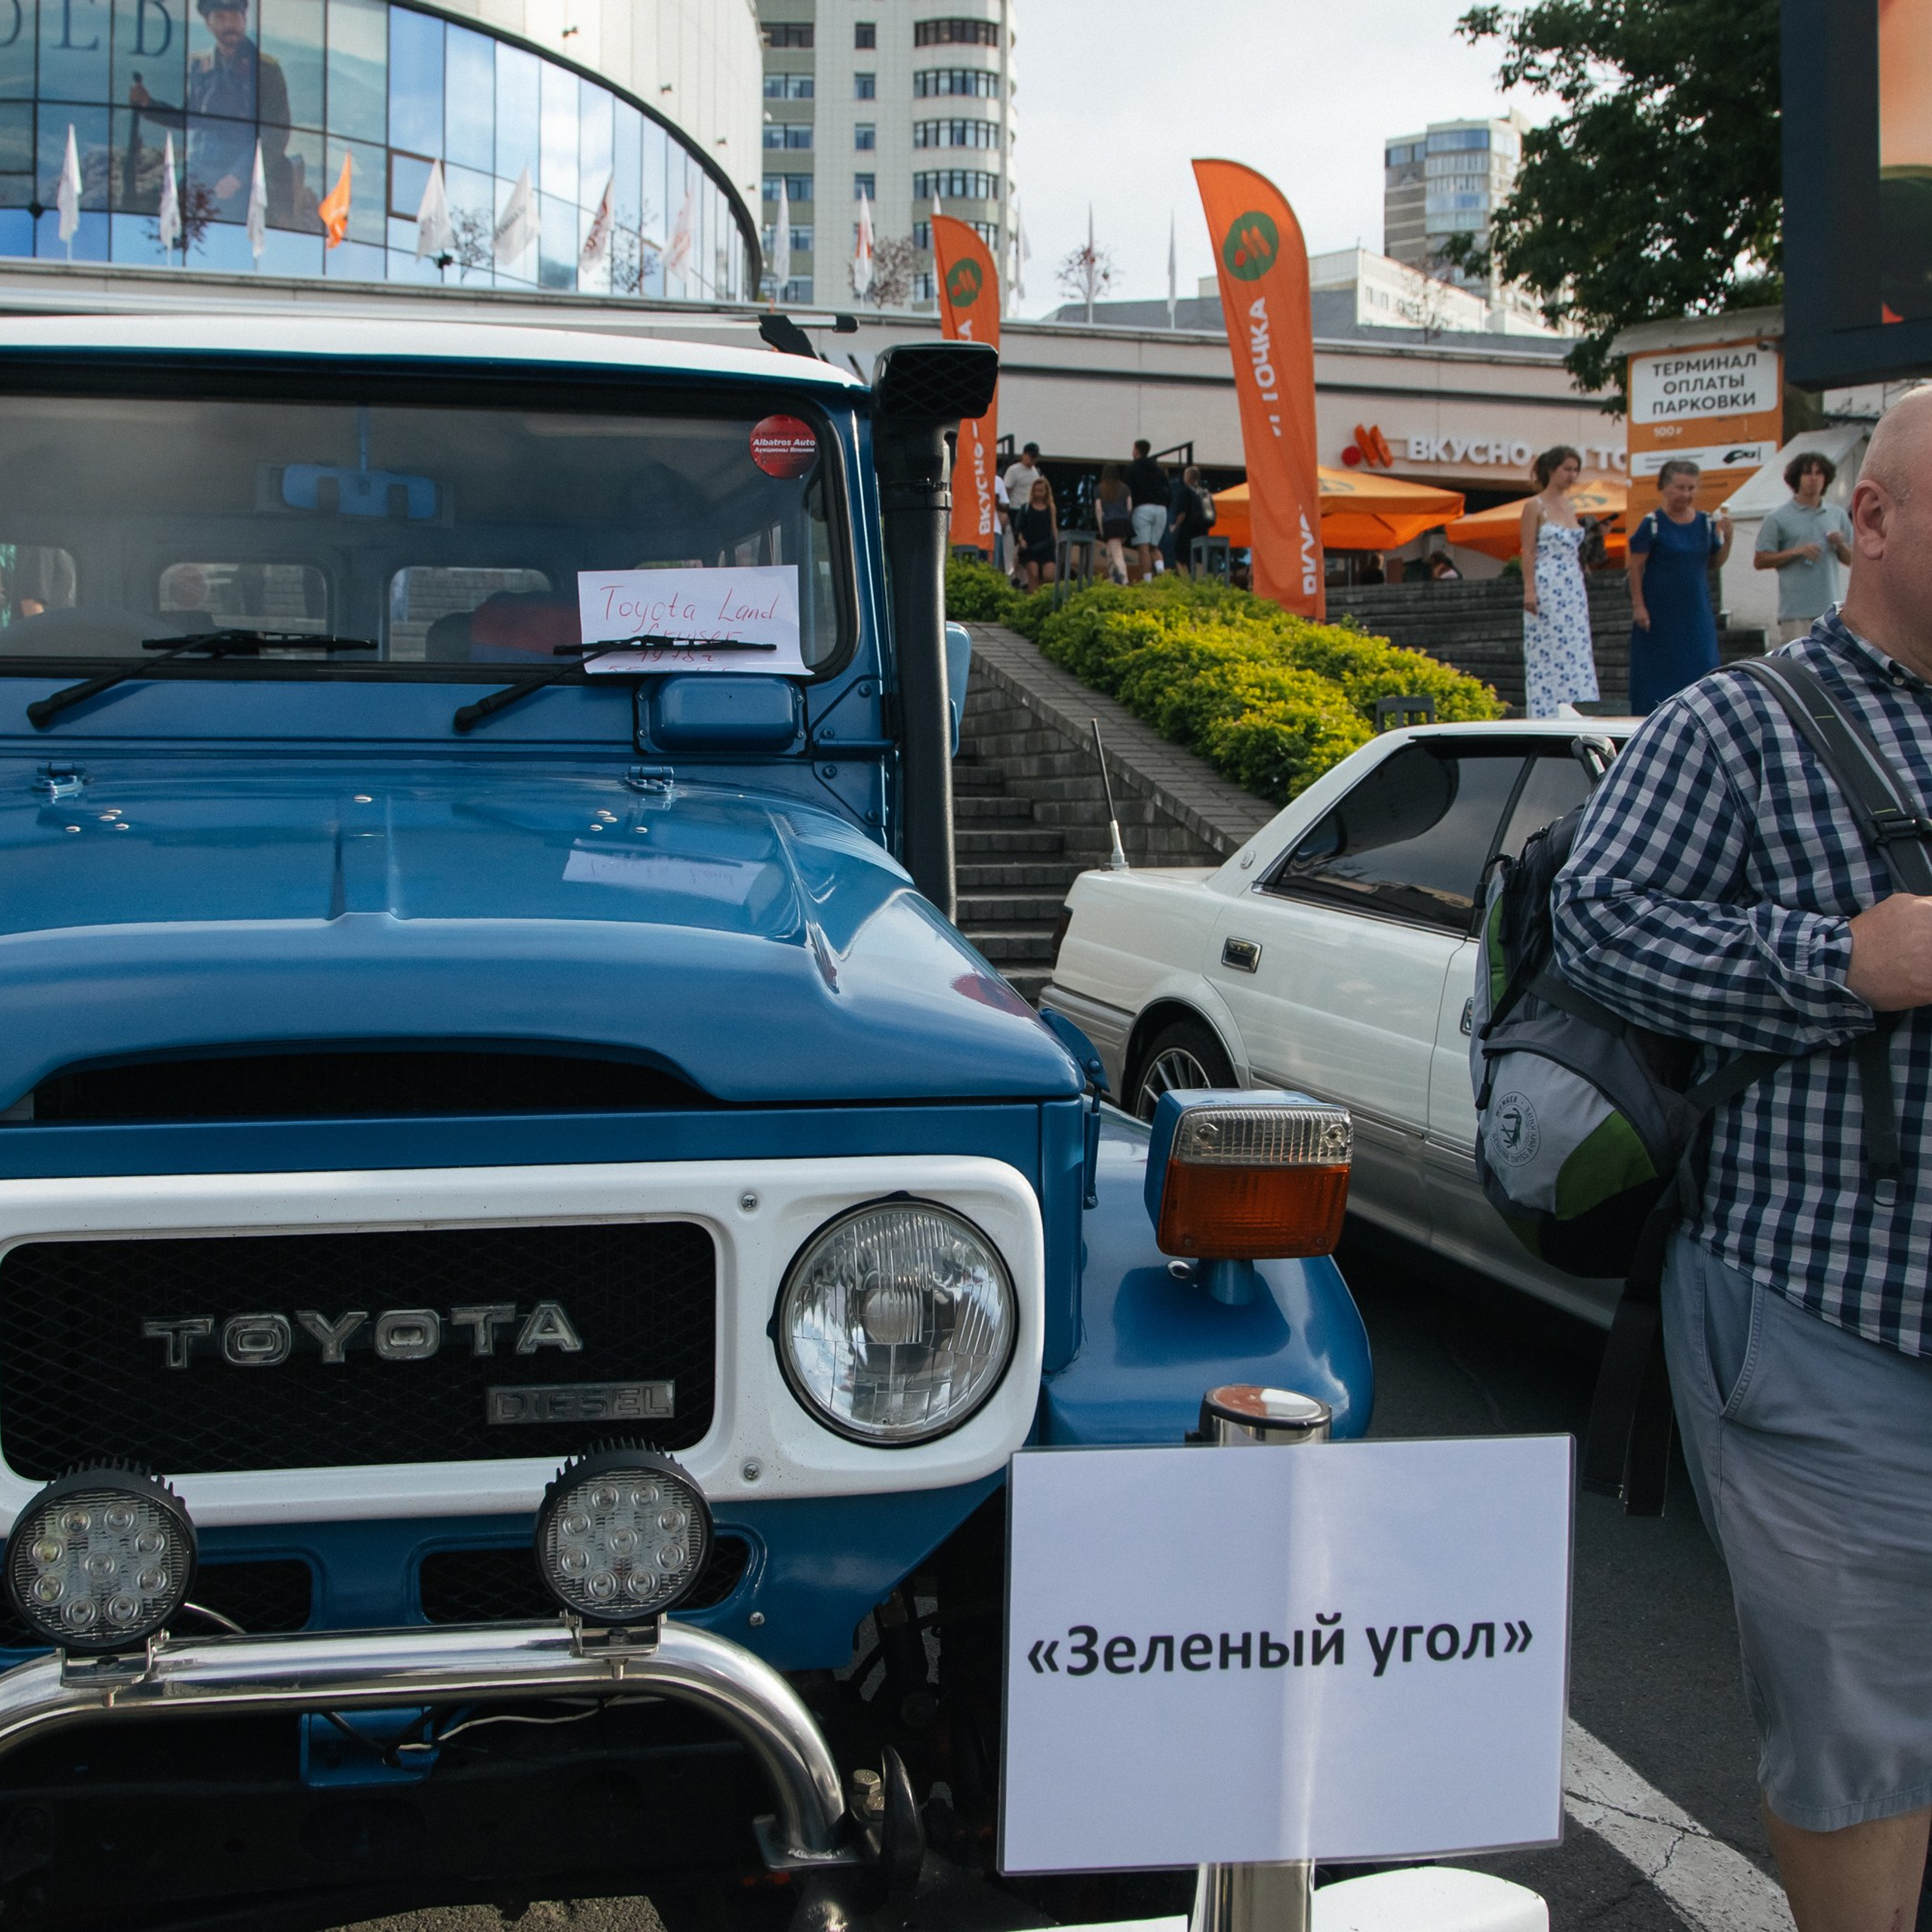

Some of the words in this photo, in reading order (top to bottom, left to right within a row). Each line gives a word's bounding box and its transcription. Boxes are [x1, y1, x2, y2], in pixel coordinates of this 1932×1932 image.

[1653, 352, 1757, 377] ТЕРМИНАЛ
[1663, 374, 1745, 395] ОПЛАТЫ
[1653, 392, 1756, 414] ПАРКОВКИ
[1407, 436, 1532, 466] ВКУСНО
[600, 586, 695, 632] Toyota
[718, 587, 780, 622] Land
[1496, 1096, 1518, 1116] WENGER
[1525, 1106, 1537, 1131] KNIFE
[1527, 1133, 1537, 1155] ARMY
[143, 1300, 583, 1367] TOYOTA
[495, 1387, 673, 1420] DIESEL
[1027, 1612, 1345, 1676] «Зеленый
[1366, 1620, 1533, 1677] угол»
